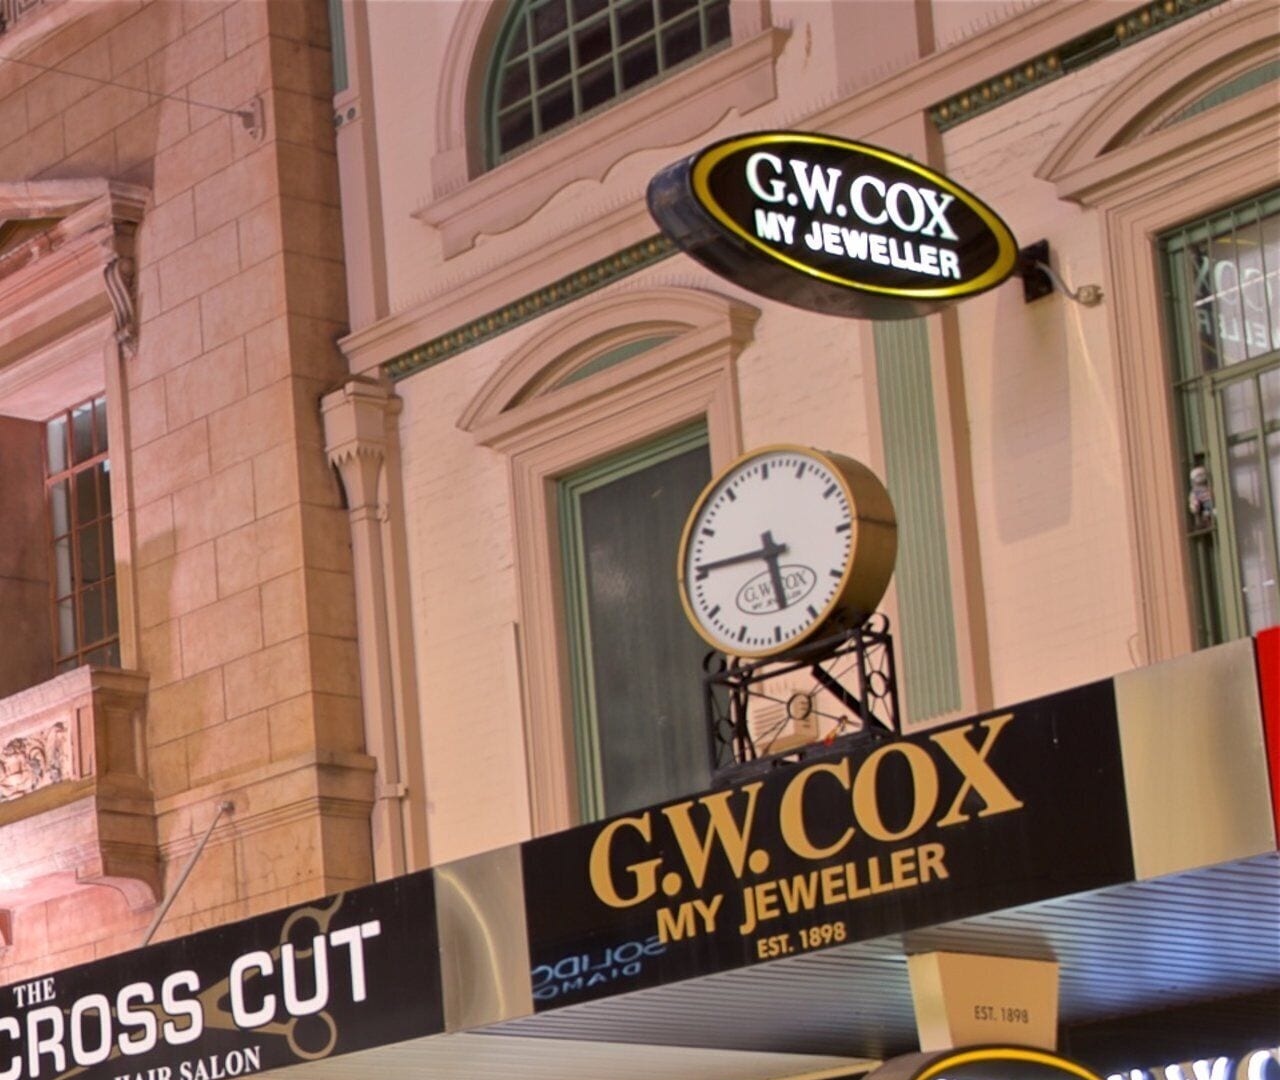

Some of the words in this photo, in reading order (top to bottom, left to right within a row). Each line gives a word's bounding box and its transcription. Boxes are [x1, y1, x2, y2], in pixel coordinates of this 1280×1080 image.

[754, 208, 796, 245] MY
[804, 221, 962, 280] JEWELLER
[656, 894, 724, 945] MY
[740, 843, 950, 936] JEWELLER
[757, 933, 795, 959] EST.
[799, 921, 847, 951] 1898
[13, 976, 56, 1008] THE
[229, 919, 381, 1029] CUT
[974, 1005, 997, 1022] EST.
[1000, 1006, 1029, 1024] 1898
